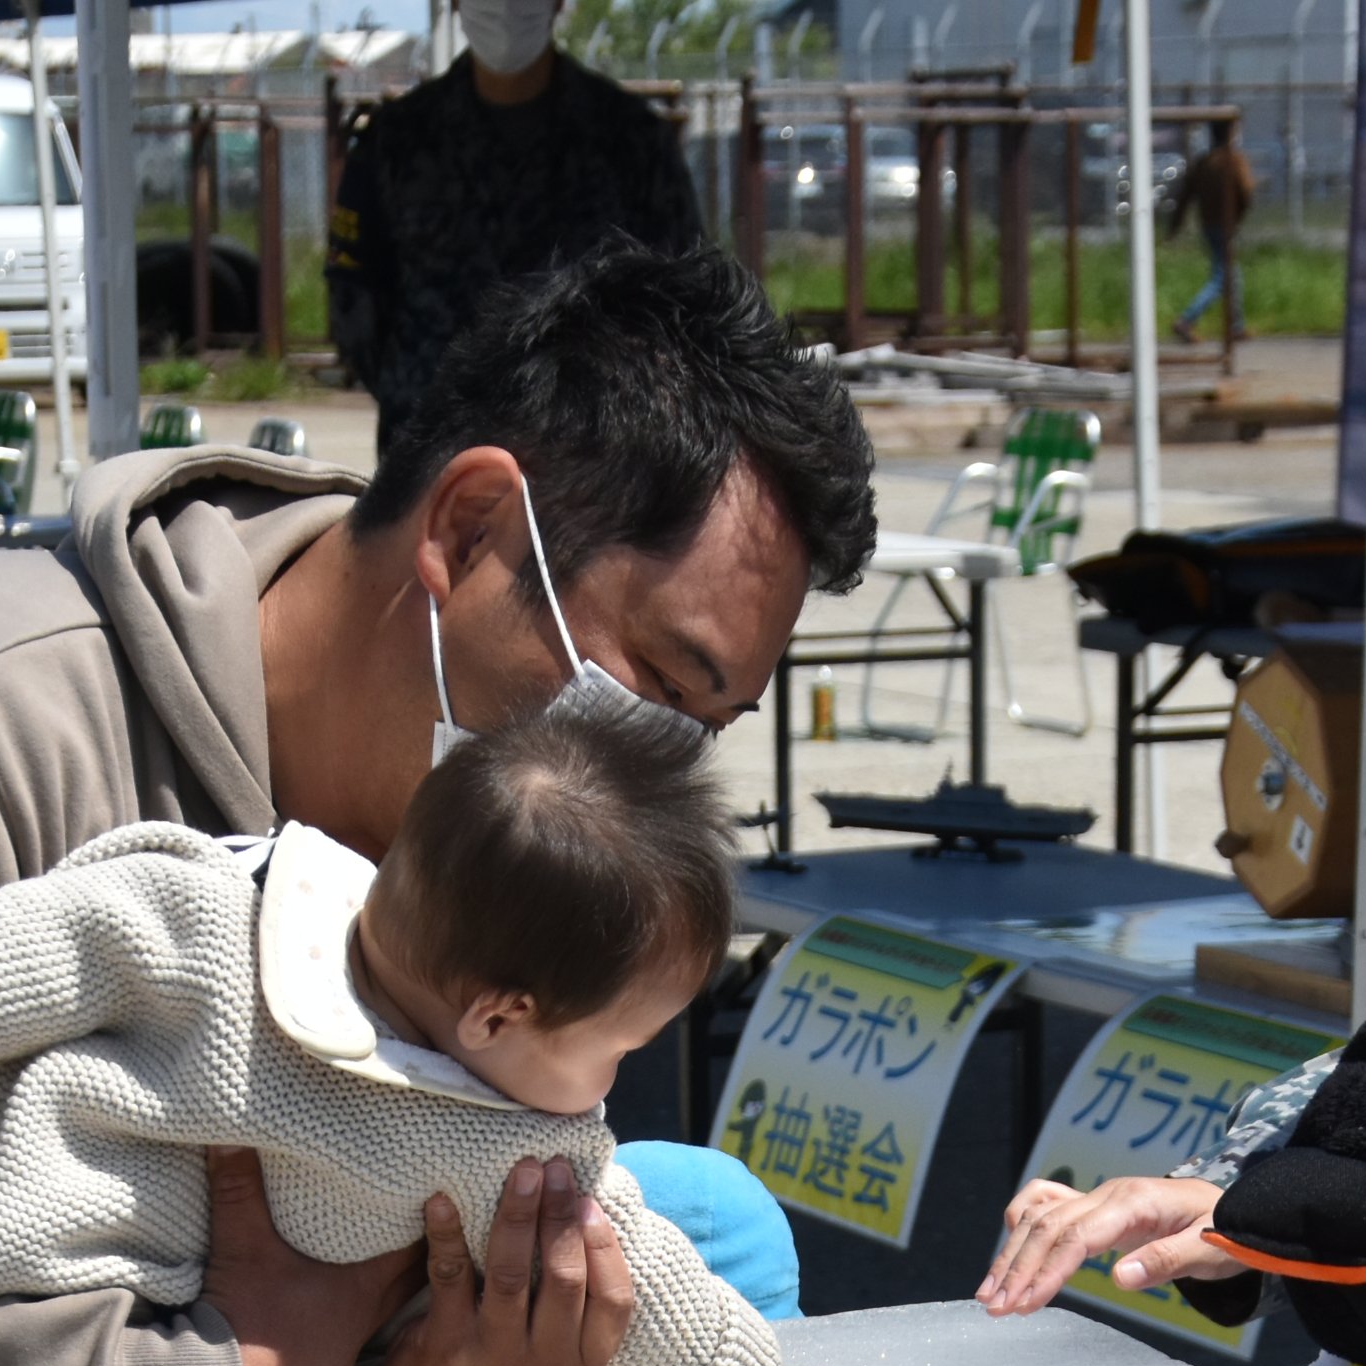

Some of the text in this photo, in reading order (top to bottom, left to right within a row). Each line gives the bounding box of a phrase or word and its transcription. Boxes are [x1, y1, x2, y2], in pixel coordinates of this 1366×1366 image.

[762, 971, 937, 1079] ガラポン
[760, 1085, 905, 1214] 抽選会
[1071, 1052, 1259, 1160] ガラポ
